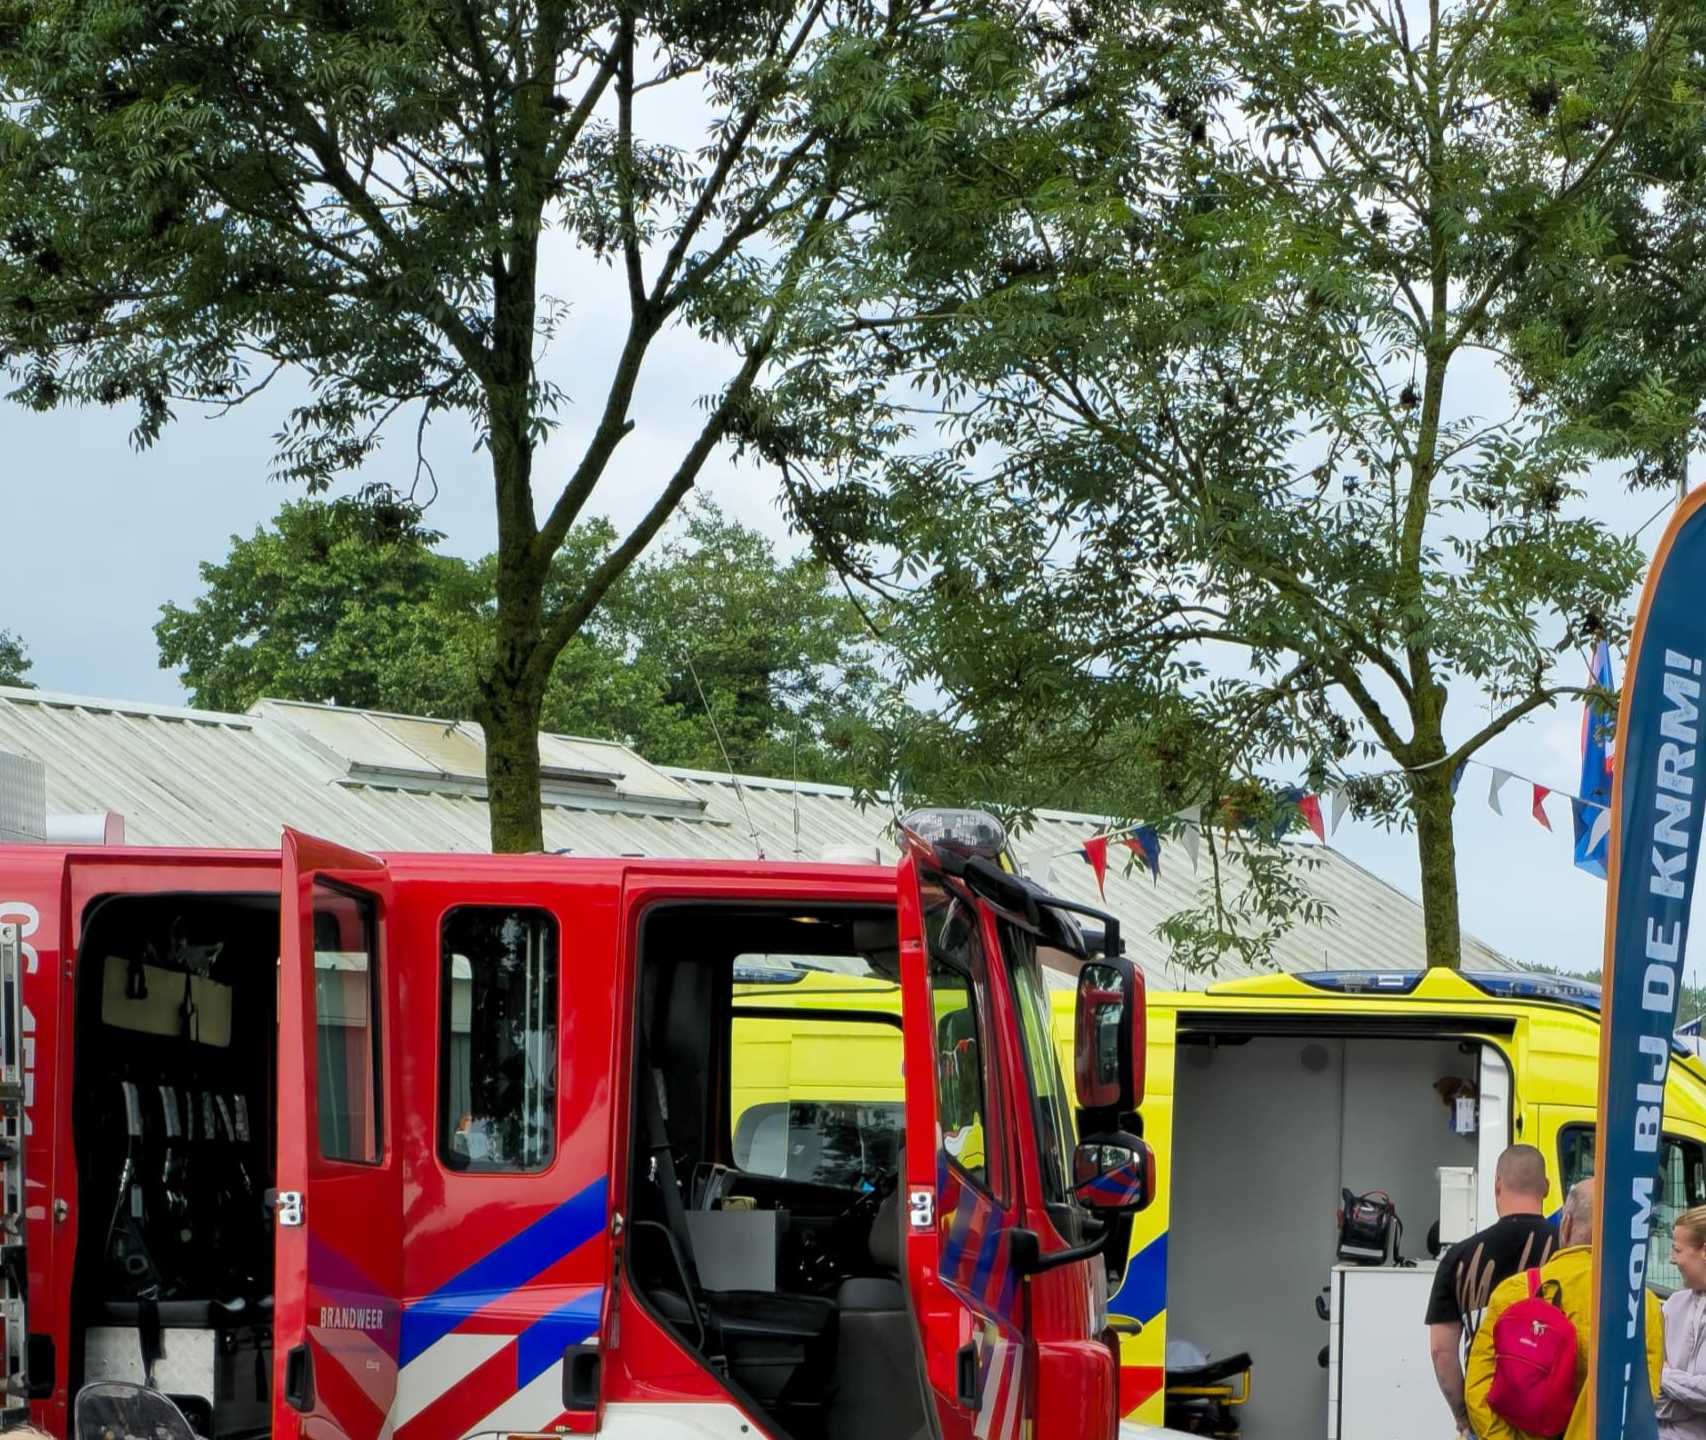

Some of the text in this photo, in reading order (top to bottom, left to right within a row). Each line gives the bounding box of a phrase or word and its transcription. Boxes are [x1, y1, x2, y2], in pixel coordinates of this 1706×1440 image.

[1650, 648, 1703, 900] KNRM!
[1641, 917, 1681, 1014] DE
[1634, 1035, 1669, 1152] BIJ
[320, 1306, 384, 1330] BRANDWEER
